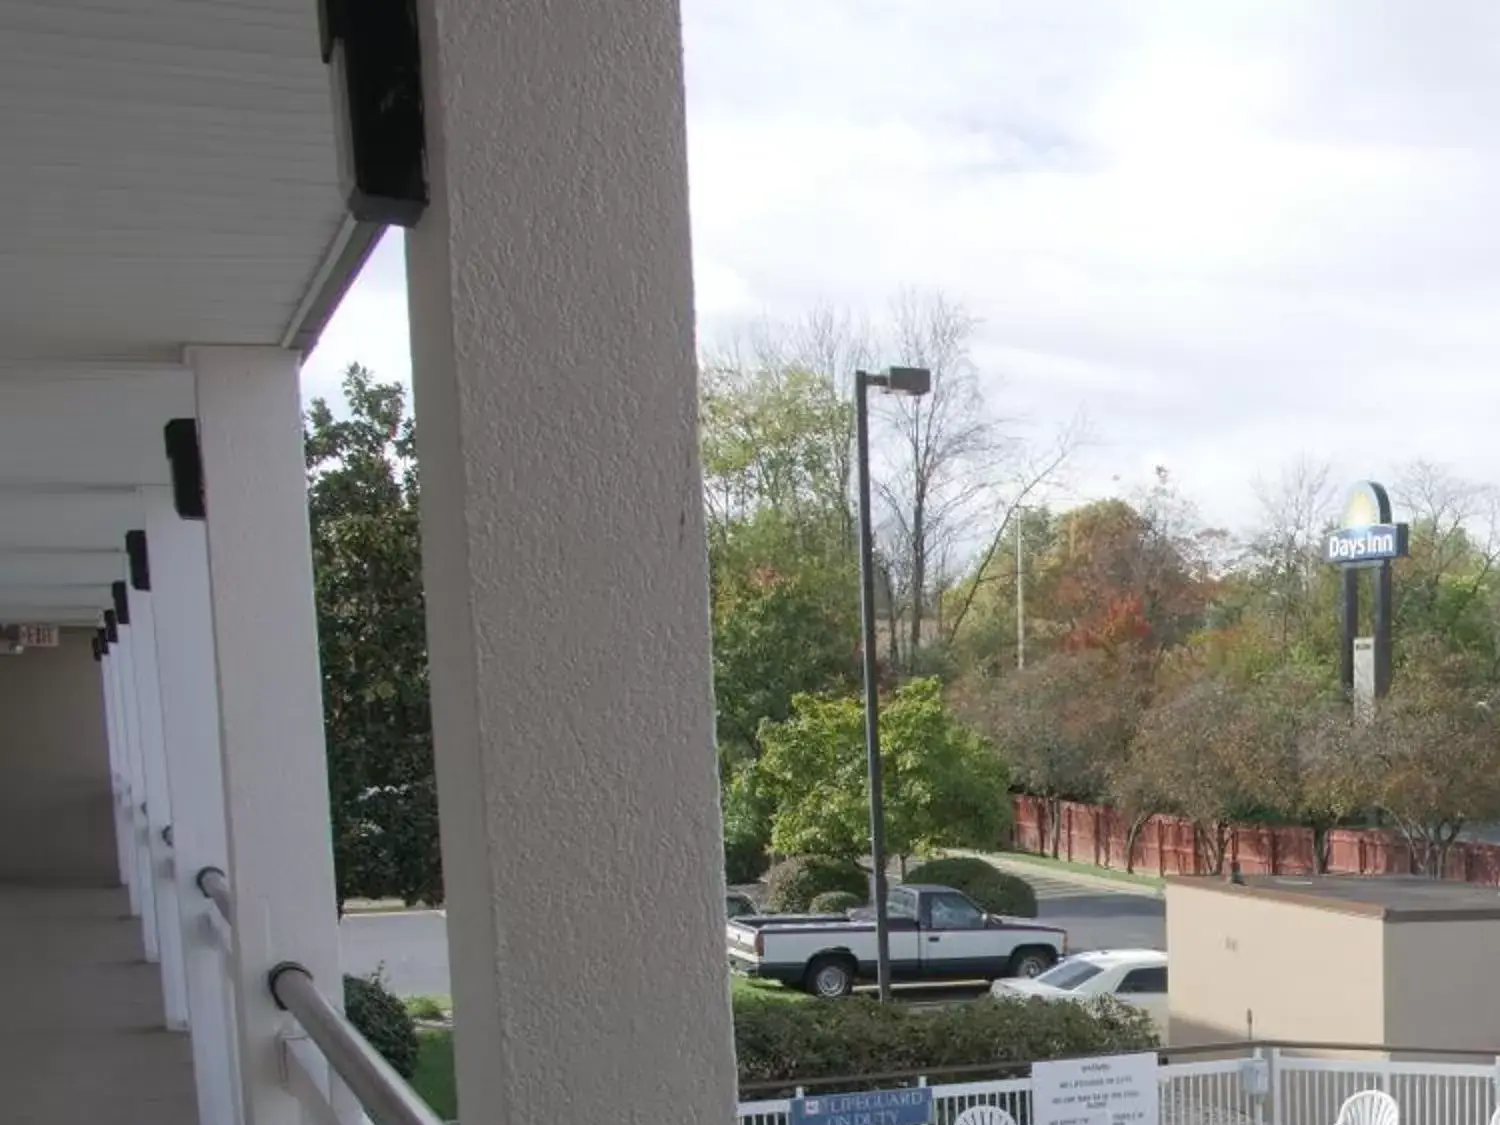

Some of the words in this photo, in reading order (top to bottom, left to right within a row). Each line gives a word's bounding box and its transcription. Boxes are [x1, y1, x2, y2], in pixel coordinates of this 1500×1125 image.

[1329, 536, 1365, 558] Days
[1367, 531, 1393, 553] Inn
[830, 1091, 923, 1112] LIFEGUARD
